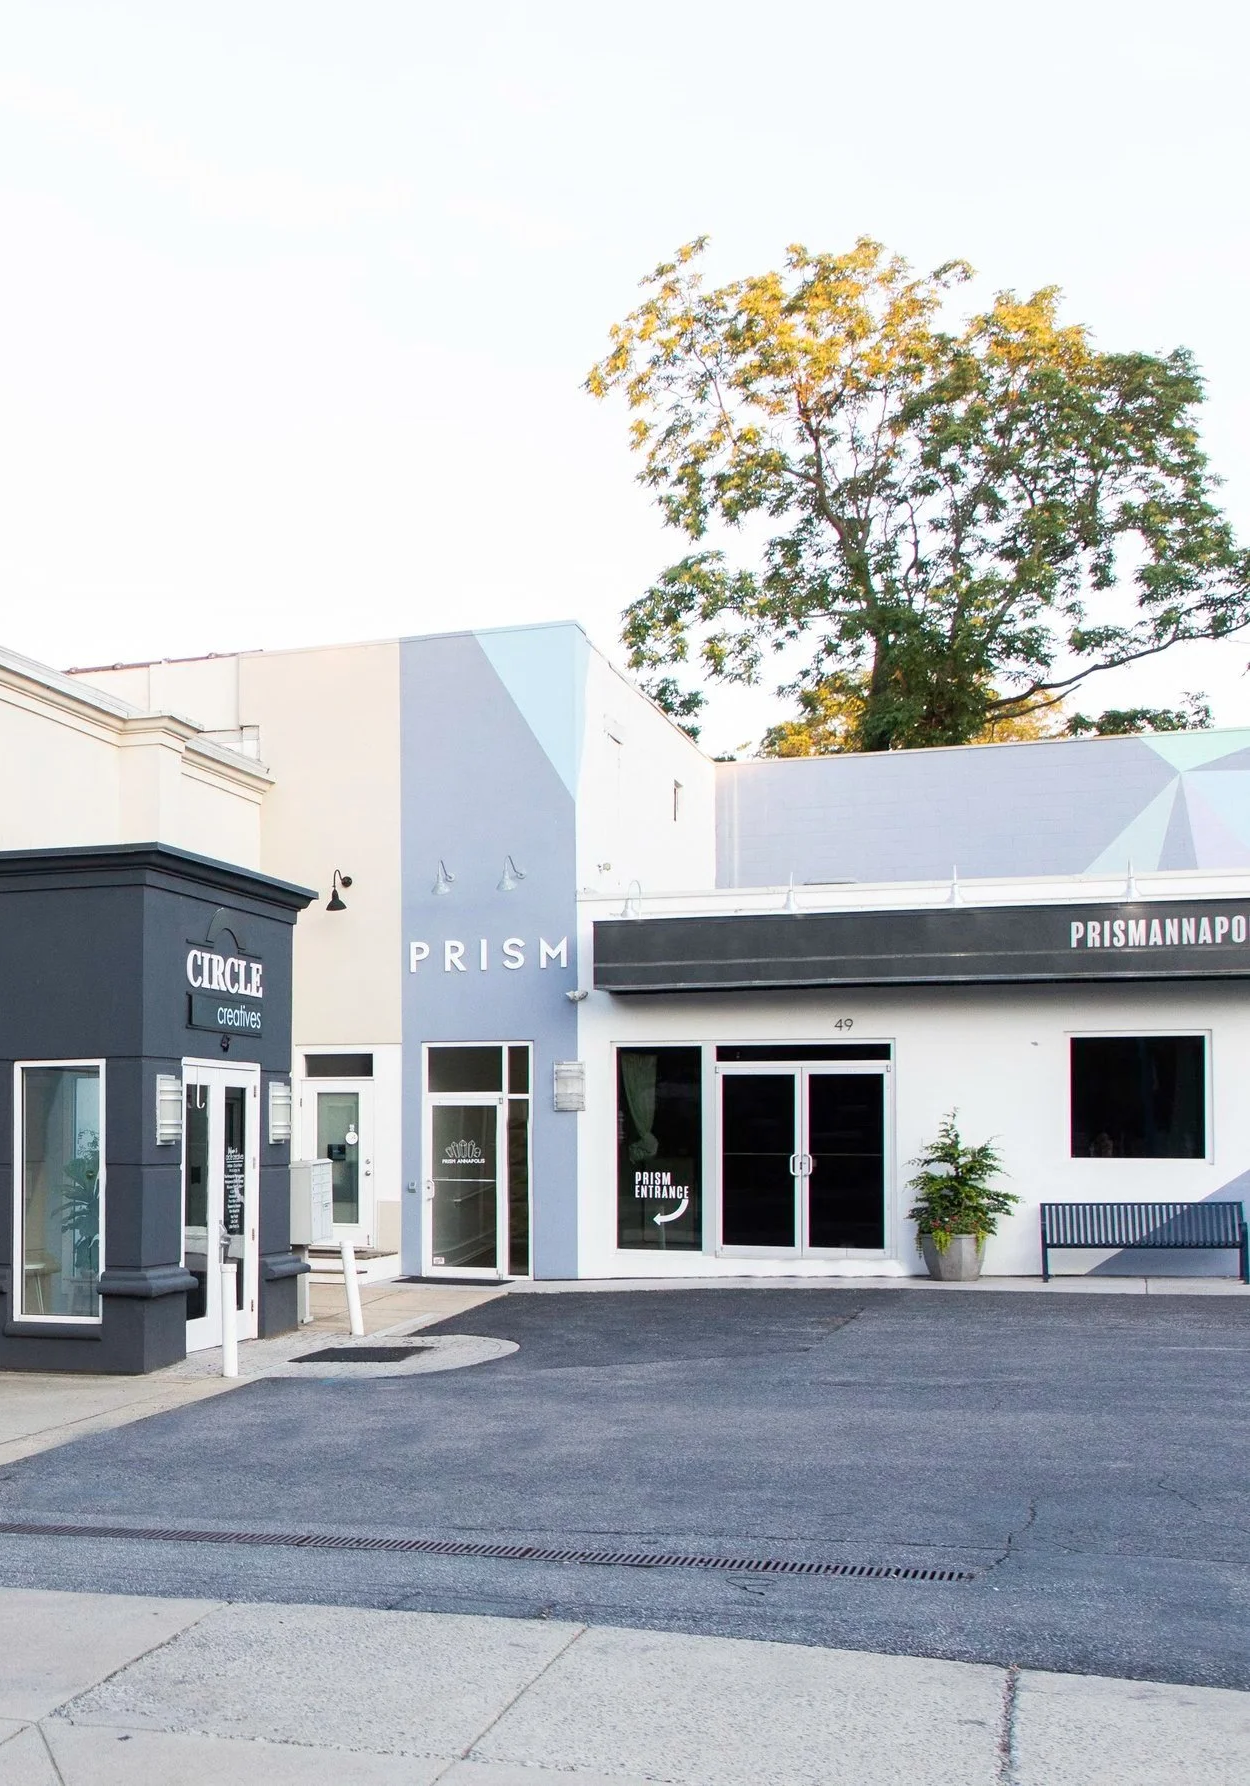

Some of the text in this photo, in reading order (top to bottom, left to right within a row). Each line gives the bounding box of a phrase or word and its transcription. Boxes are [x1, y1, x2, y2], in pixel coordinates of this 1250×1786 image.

[1070, 915, 1250, 948] PRISMANNAPO
[409, 936, 568, 973] PRISM
[186, 949, 263, 998] CIRCLE
[217, 1005, 262, 1029] creatives
[834, 1018, 854, 1031] 49
[635, 1171, 671, 1186] PRISM
[634, 1185, 689, 1199] ENTRANCE
